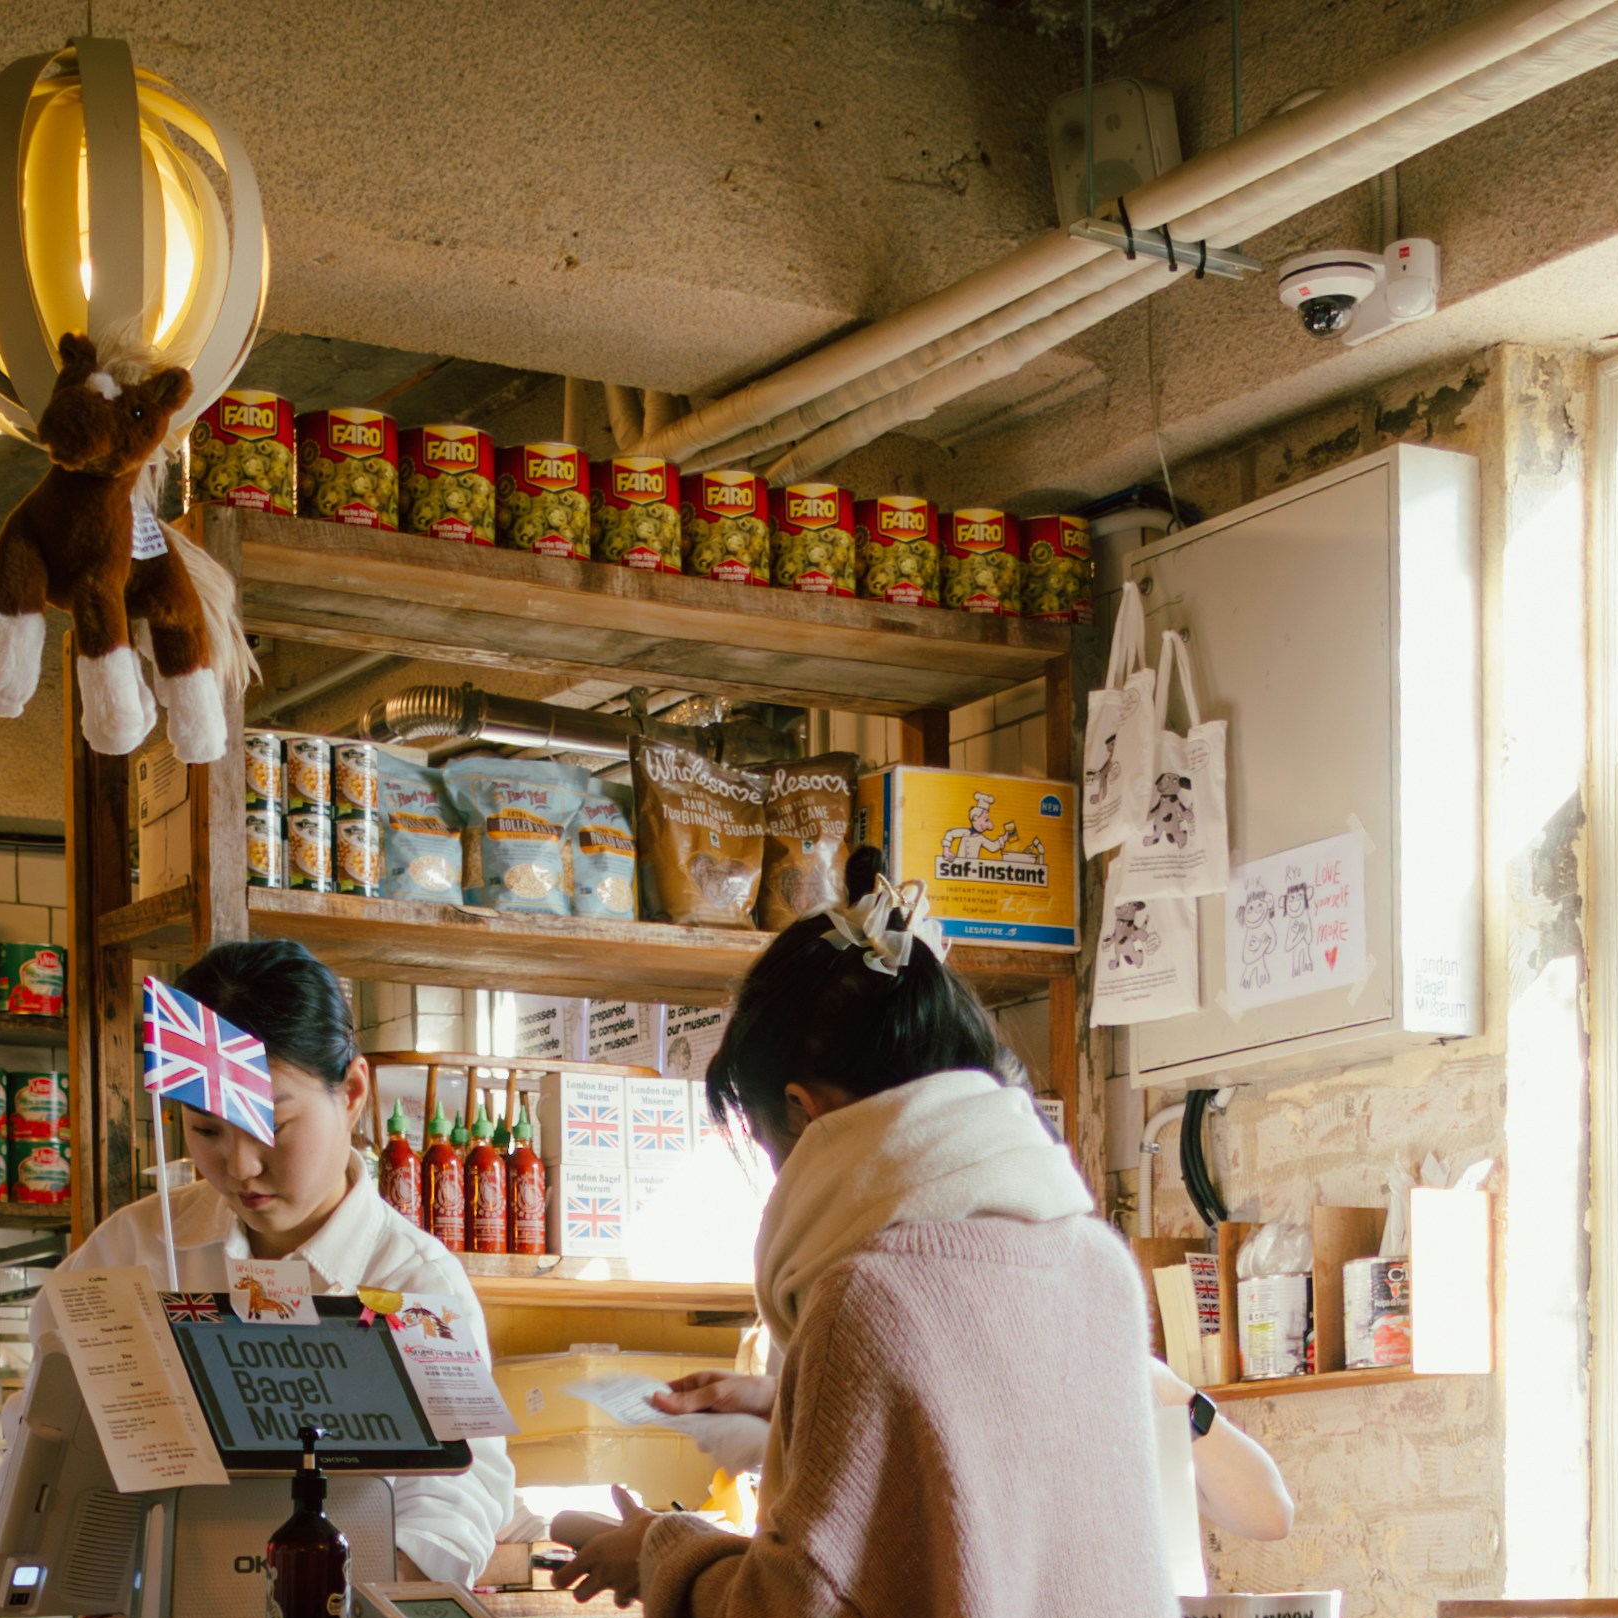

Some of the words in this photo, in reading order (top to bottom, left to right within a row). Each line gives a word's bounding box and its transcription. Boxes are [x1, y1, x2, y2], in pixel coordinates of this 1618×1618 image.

[224, 405, 274, 429] FARO
[333, 425, 380, 447] FARO
[427, 441, 476, 462] FARO
[528, 459, 575, 481] FARO
[616, 473, 663, 493] FARO
[707, 486, 752, 506] FARO
[790, 499, 835, 519] FARO
[882, 511, 924, 530] FARO
[957, 524, 1002, 542] FARO
[645, 749, 762, 804] Wholesome
[682, 798, 706, 811] RAW
[708, 804, 734, 823] CANE
[800, 805, 829, 823] CANE
[1042, 801, 1059, 813] NEW
[499, 818, 532, 832] ROLLED
[662, 805, 721, 834] TURBINADO
[724, 823, 764, 837] SUGAR
[939, 861, 1045, 885] saf-instant
[1314, 860, 1342, 887] LOVE
[947, 886, 975, 895] INSTANT
[977, 887, 998, 896] YEAST
[1314, 884, 1350, 917] yourself
[964, 927, 1004, 936] LESAFFRE
[1316, 919, 1349, 946] MORE
[1416, 954, 1458, 976] London
[1415, 974, 1447, 1001] Bagel
[589, 1004, 627, 1024] prepared
[1415, 995, 1468, 1019] Museum
[598, 1017, 635, 1036] complete
[667, 1024, 681, 1036] our
[684, 1013, 721, 1031] museum
[589, 1043, 602, 1056] our
[604, 1033, 638, 1050] museum
[566, 1081, 597, 1091] London
[598, 1084, 619, 1093] Bagel
[577, 1092, 609, 1102] Museum
[631, 1086, 660, 1095] London
[662, 1088, 683, 1097] Bagel
[641, 1096, 674, 1106] Museum
[566, 1173, 597, 1183] London
[599, 1175, 621, 1184] Bagel
[577, 1184, 611, 1194] Museum
[220, 1334, 347, 1369] London
[233, 1370, 332, 1411] Bagel
[246, 1406, 402, 1441] Museum
